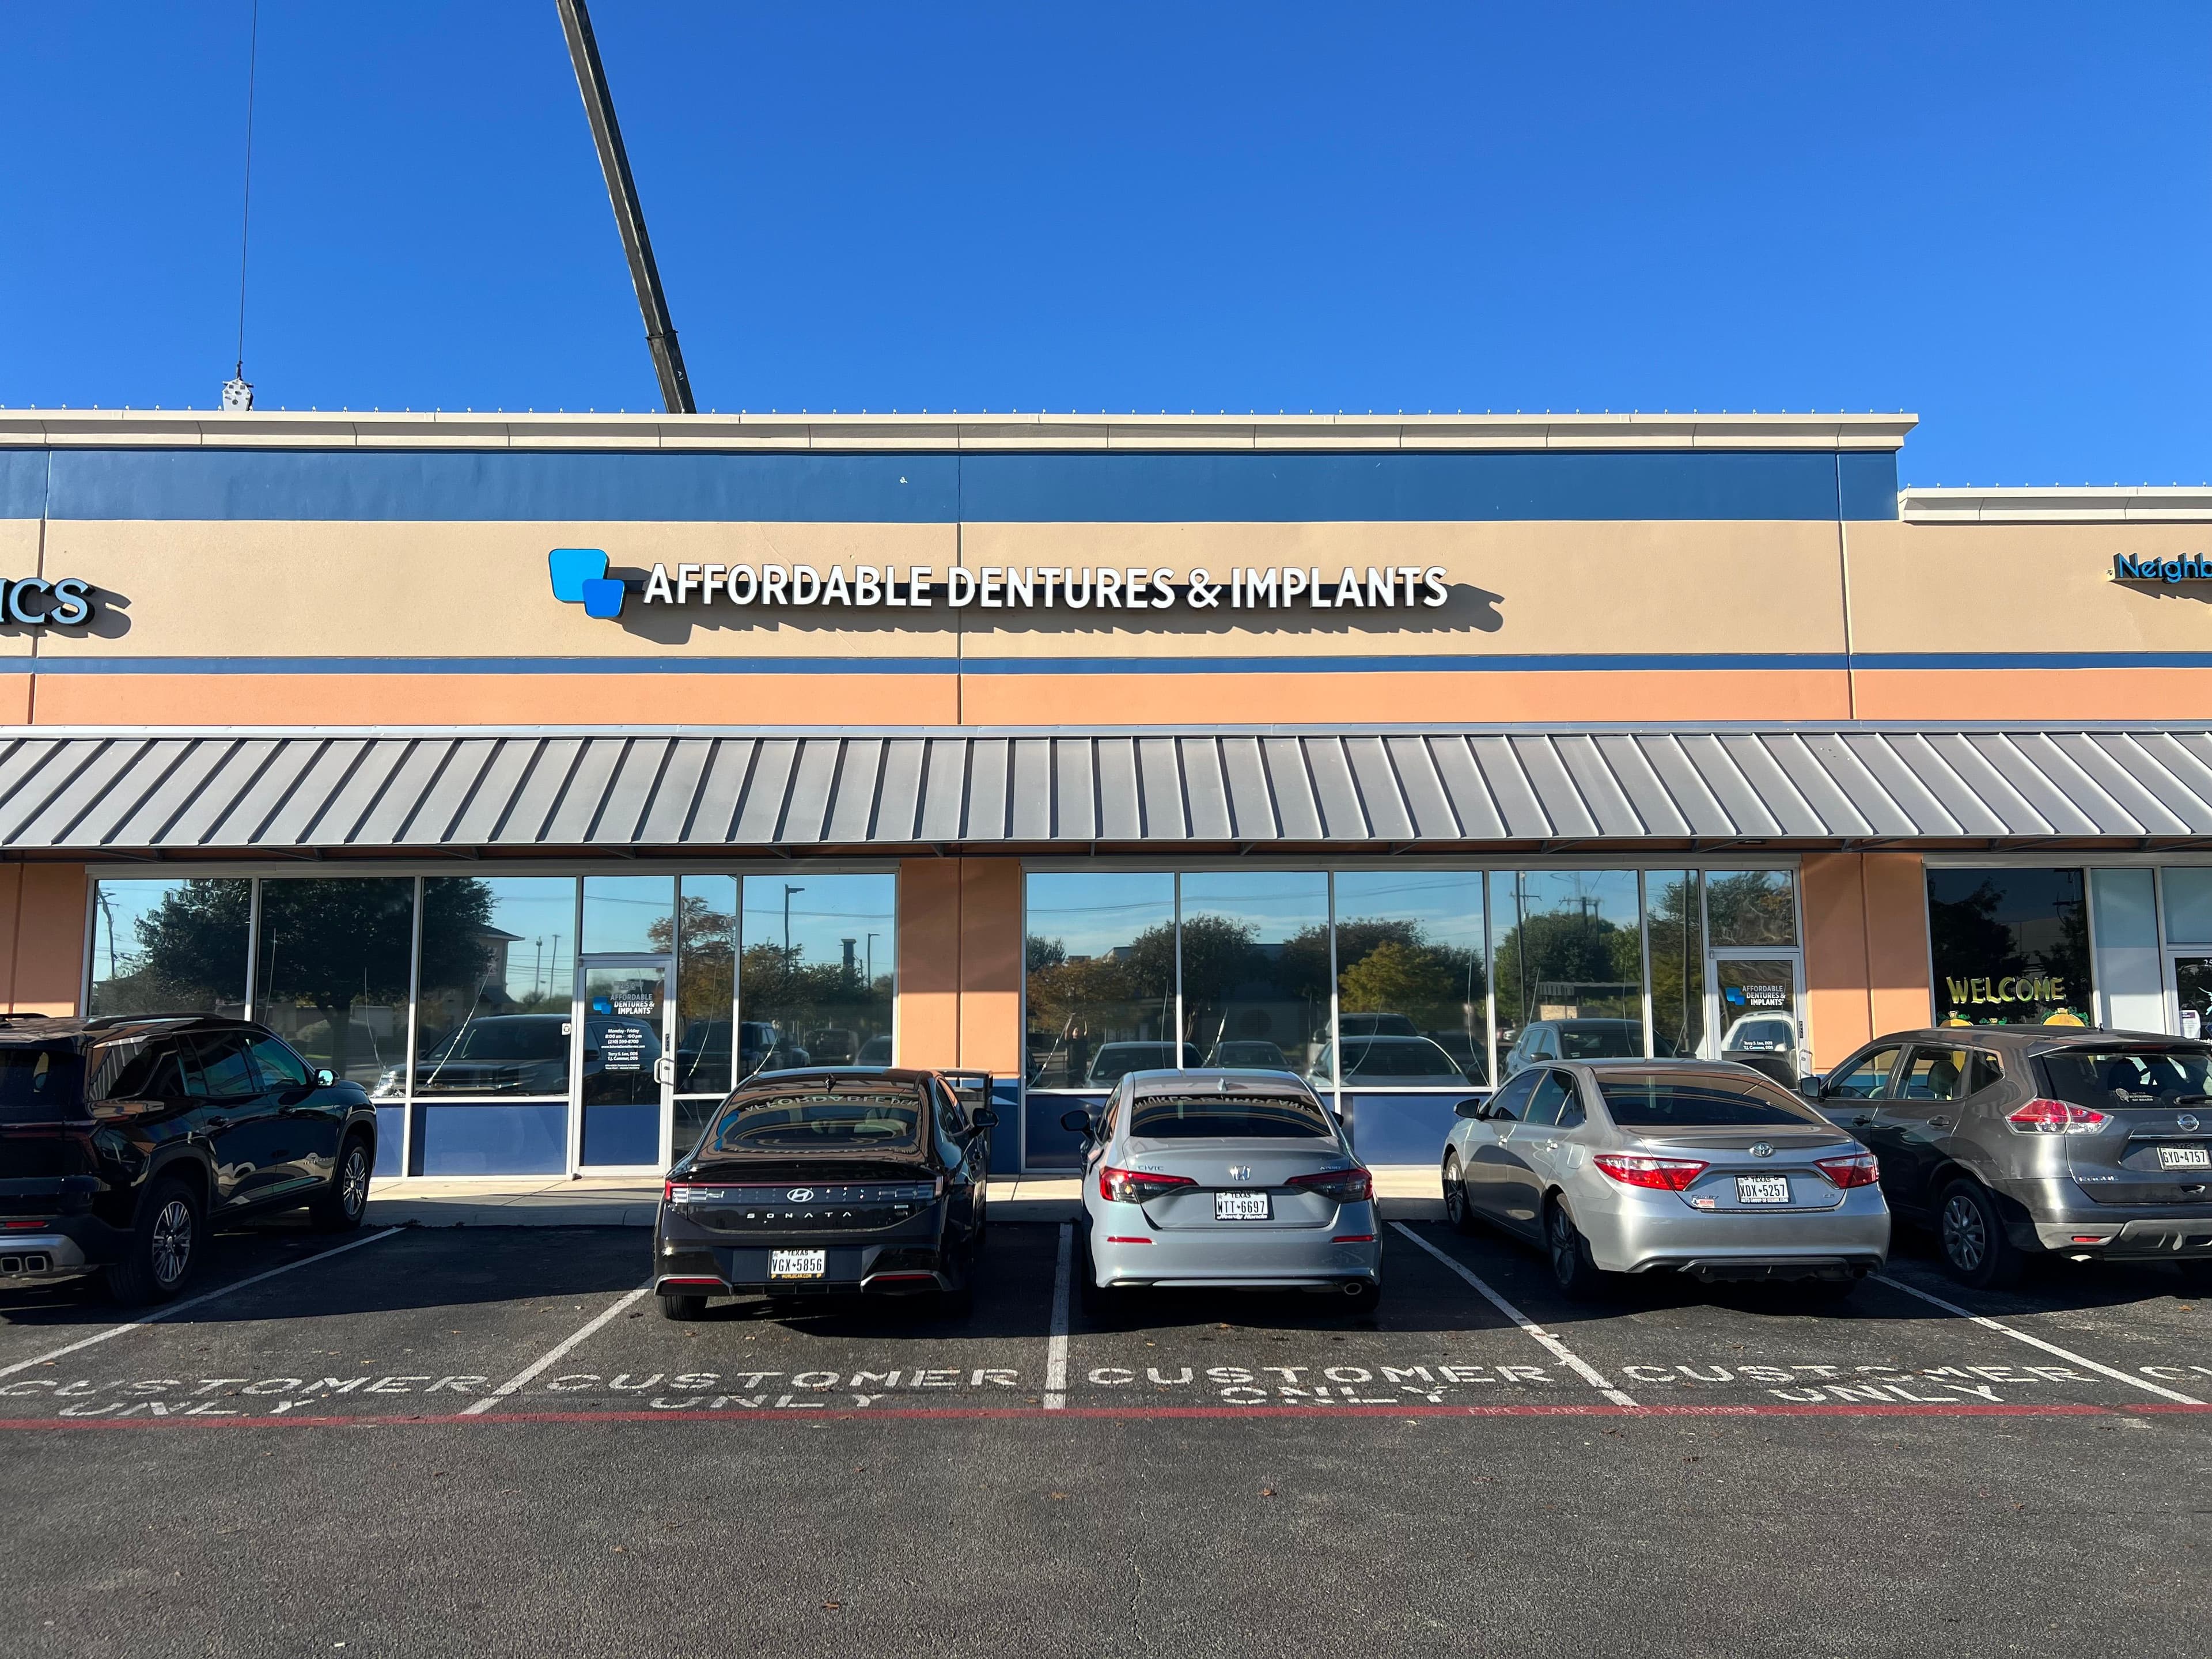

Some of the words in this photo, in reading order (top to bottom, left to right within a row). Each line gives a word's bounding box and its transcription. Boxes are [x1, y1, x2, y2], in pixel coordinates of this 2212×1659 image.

[643, 563, 932, 607] AFFORDABLE
[948, 566, 1177, 608] DENTURES
[1187, 567, 1220, 608] &
[1231, 566, 1448, 608] IMPLANTS
[1946, 976, 2066, 1004] WELCOME
[545, 1369, 1021, 1391] CUSTOMER
[1087, 1365, 1556, 1385] CUSTOMER
[1622, 1363, 2101, 1382] CUSTOMER
[0, 1376, 490, 1395] CUSTOMER
[1219, 1385, 1452, 1405] ONLY
[1768, 1384, 2005, 1402] ONLY
[58, 1399, 316, 1416] ONLY
[649, 1394, 887, 1408] ONLY
